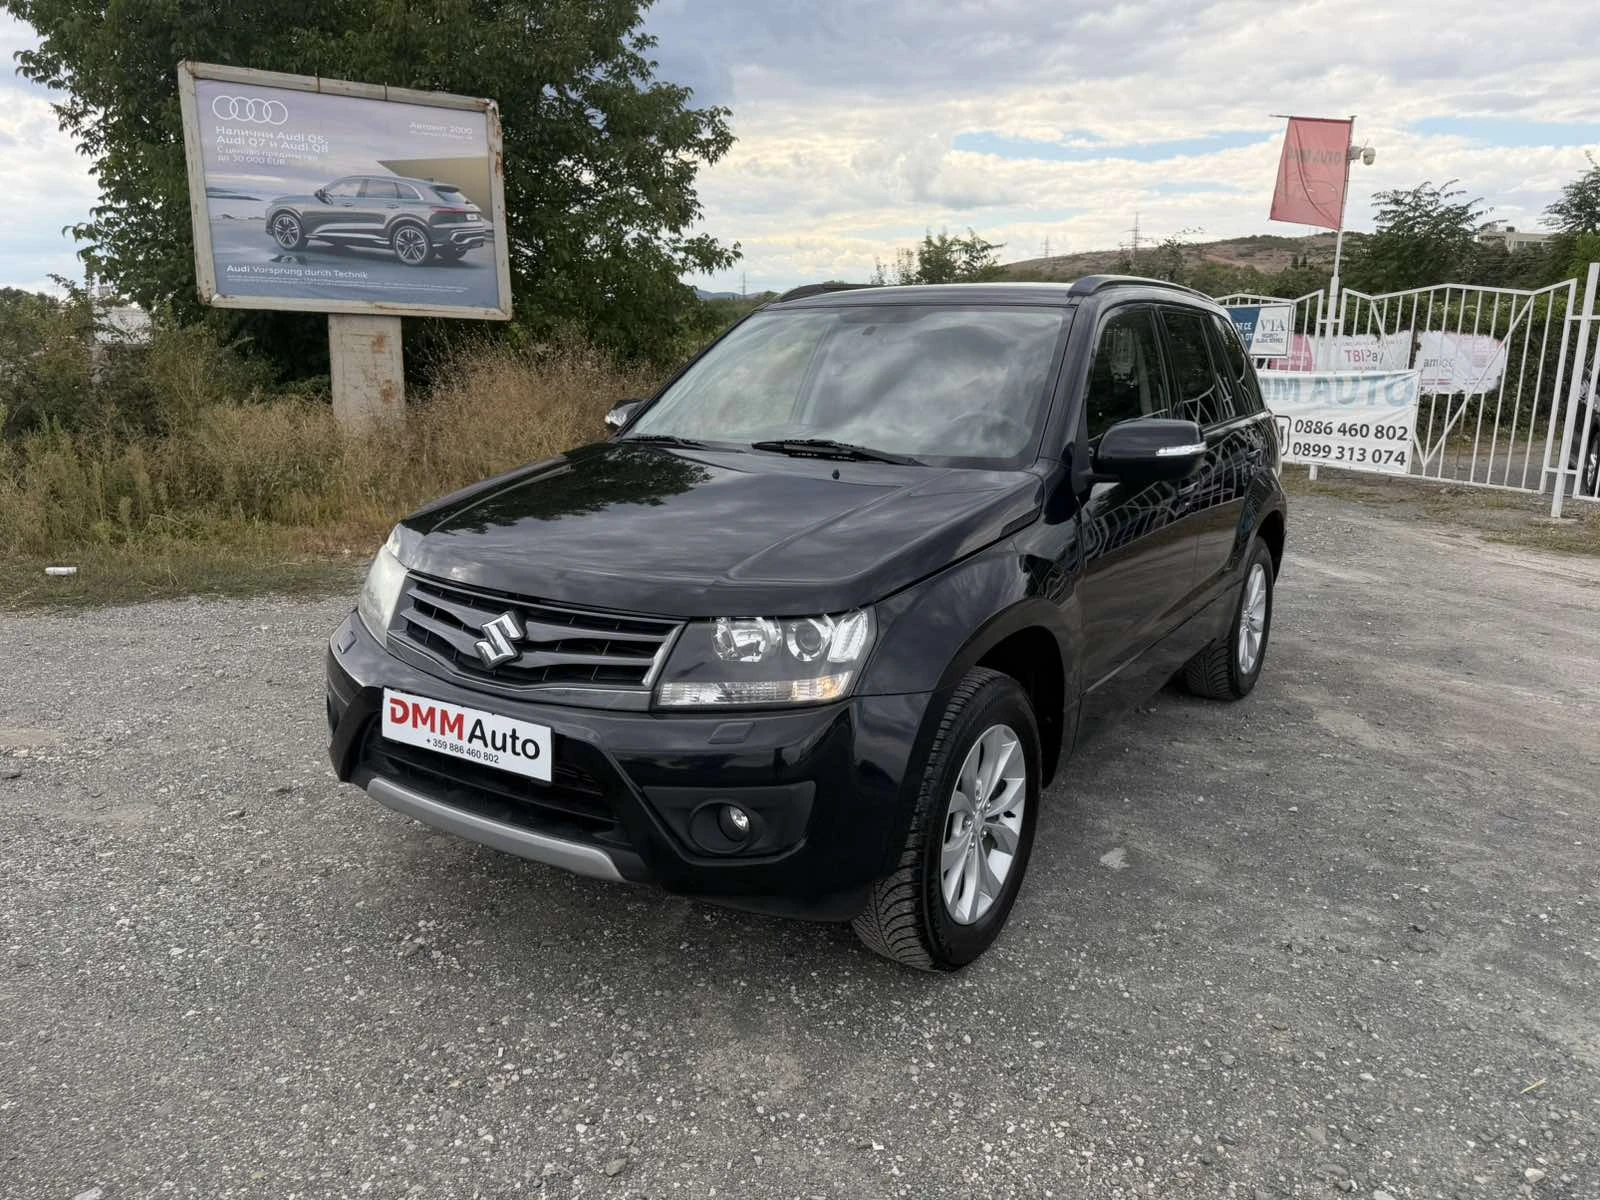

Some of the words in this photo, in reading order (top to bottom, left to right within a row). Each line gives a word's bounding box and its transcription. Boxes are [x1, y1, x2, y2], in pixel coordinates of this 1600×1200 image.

[216, 135, 245, 145] Audi
[281, 141, 308, 152] Audi
[277, 131, 304, 142] Audi
[226, 264, 250, 273] Audi
[252, 265, 303, 276] Vorsprung
[305, 267, 332, 277] durch
[334, 269, 369, 280] Technik
[1311, 374, 1415, 408] AUTO
[1294, 419, 1333, 436] 0886
[1337, 421, 1370, 438] 460
[1374, 424, 1408, 441] 802
[1292, 441, 1332, 458] 0899
[1335, 446, 1366, 462] 313
[1371, 448, 1407, 466] 074
[432, 738, 448, 750] 359
[449, 743, 465, 755] 886
[466, 748, 482, 759] 460
[483, 752, 500, 764] 802
